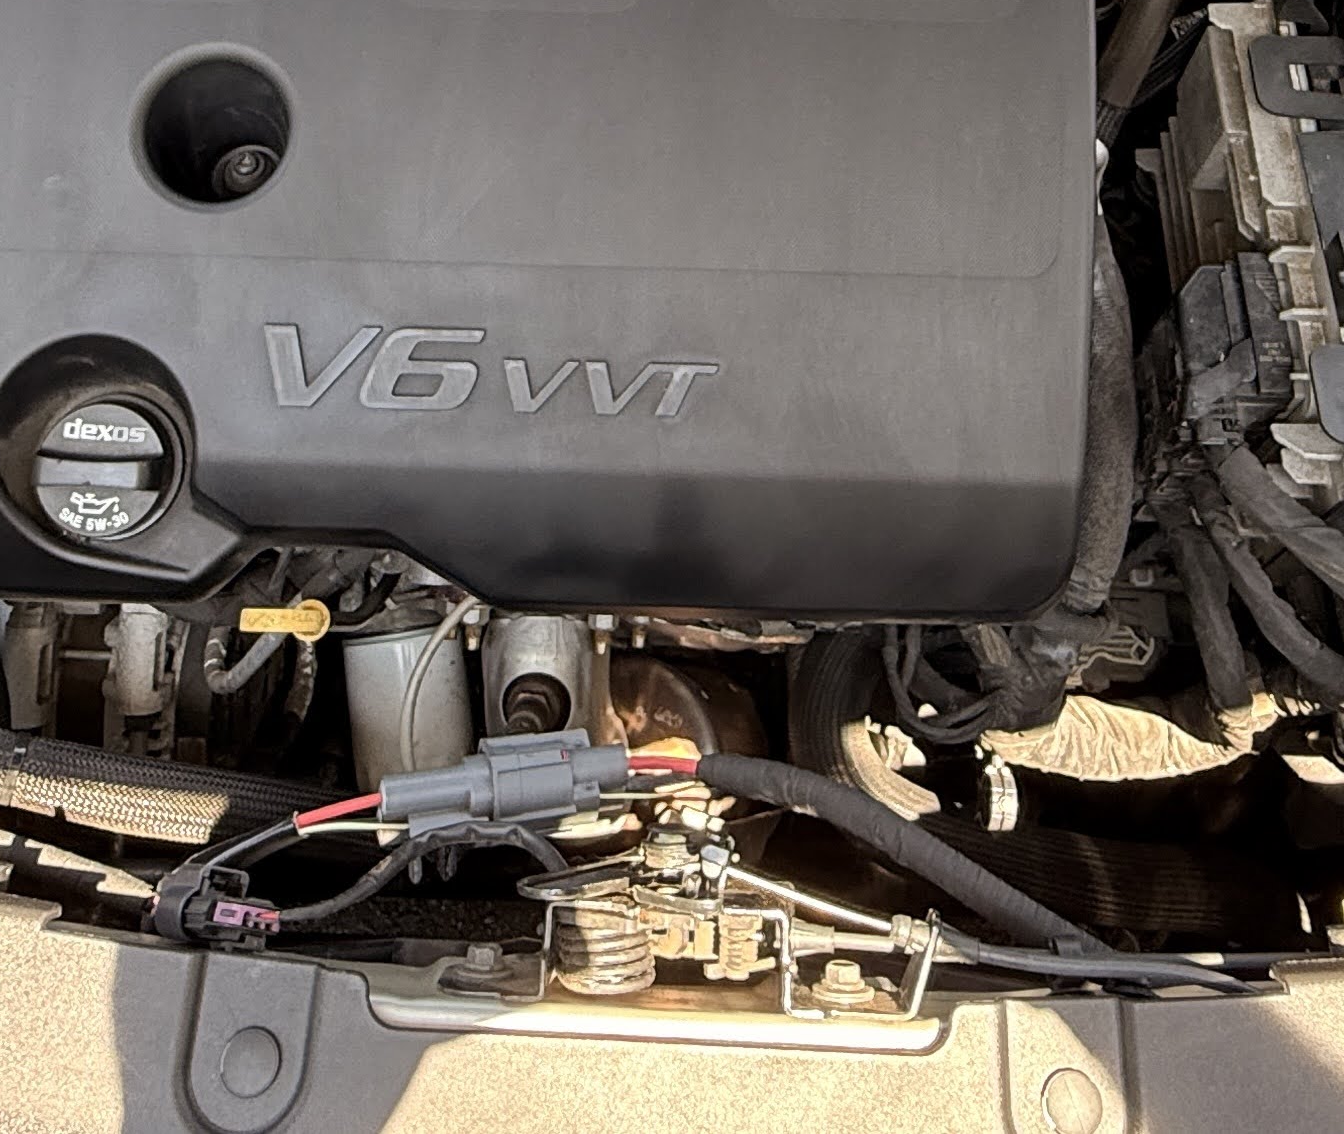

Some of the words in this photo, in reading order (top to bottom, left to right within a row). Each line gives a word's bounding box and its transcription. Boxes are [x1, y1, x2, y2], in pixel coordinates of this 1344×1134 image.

[262, 321, 487, 412] V6
[502, 357, 721, 419] VVT
[62, 418, 147, 443] dexos
[59, 507, 82, 529] SAE
[85, 510, 130, 532] 5W-30
